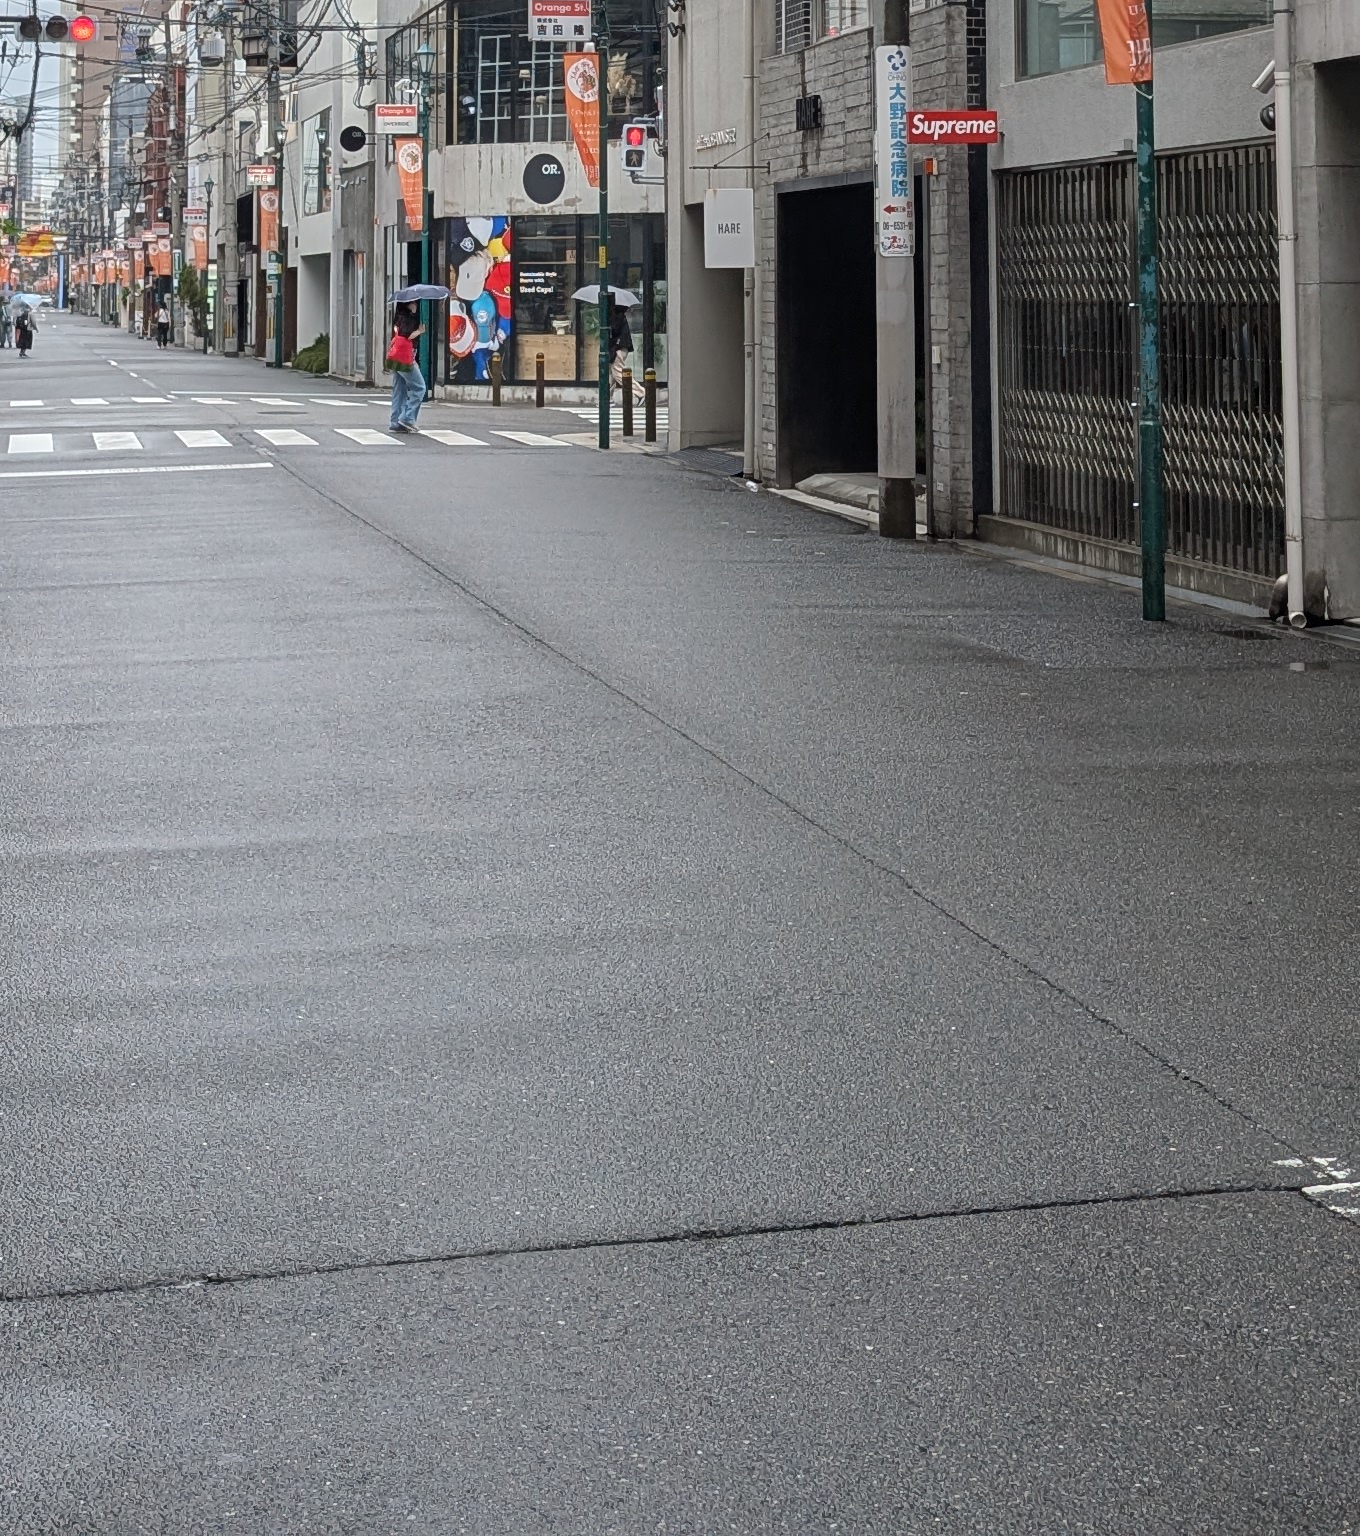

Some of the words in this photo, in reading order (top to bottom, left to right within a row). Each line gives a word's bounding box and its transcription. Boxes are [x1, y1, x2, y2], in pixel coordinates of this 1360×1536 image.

[534, 2, 572, 14] Orange
[911, 114, 996, 141] Supreme
[889, 82, 909, 198] 大野記念病院
[542, 164, 561, 175] OR.
[717, 223, 741, 235] HARE
